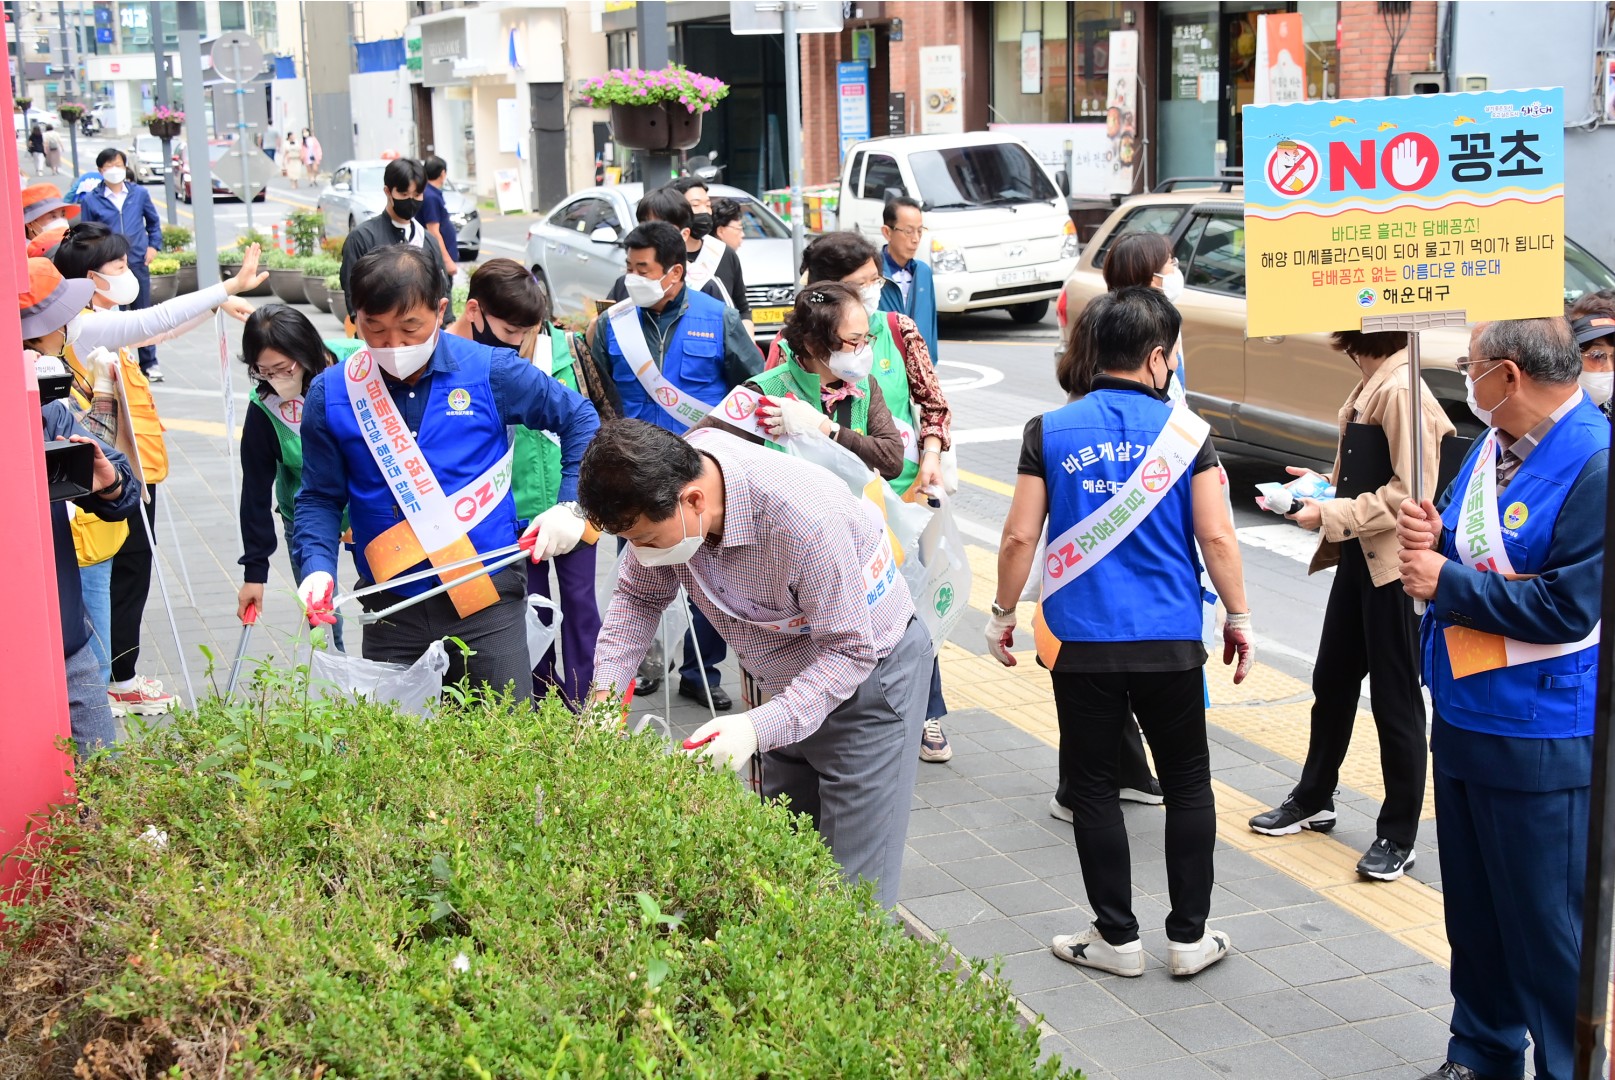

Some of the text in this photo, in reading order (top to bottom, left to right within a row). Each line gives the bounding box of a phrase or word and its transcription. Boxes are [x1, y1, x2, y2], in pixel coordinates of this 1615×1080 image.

[1449, 130, 1543, 182] 꽁초
[1261, 234, 1554, 269] 해양 미세플라스틱이 되어 물고기 먹이가 됩니다
[1332, 223, 1372, 242] 바다로
[1423, 218, 1480, 237] 담배꽁초!
[1312, 259, 1501, 287] 담배꽁초 없는 아름다운 해운대
[1383, 285, 1450, 304] 해운대구
[356, 398, 421, 513] 아름다운 해운대 만들기
[366, 379, 434, 496] 담배꽁초 없는
[1075, 488, 1146, 554] 담배꽁초
[1465, 471, 1490, 559] 담배꽁초
